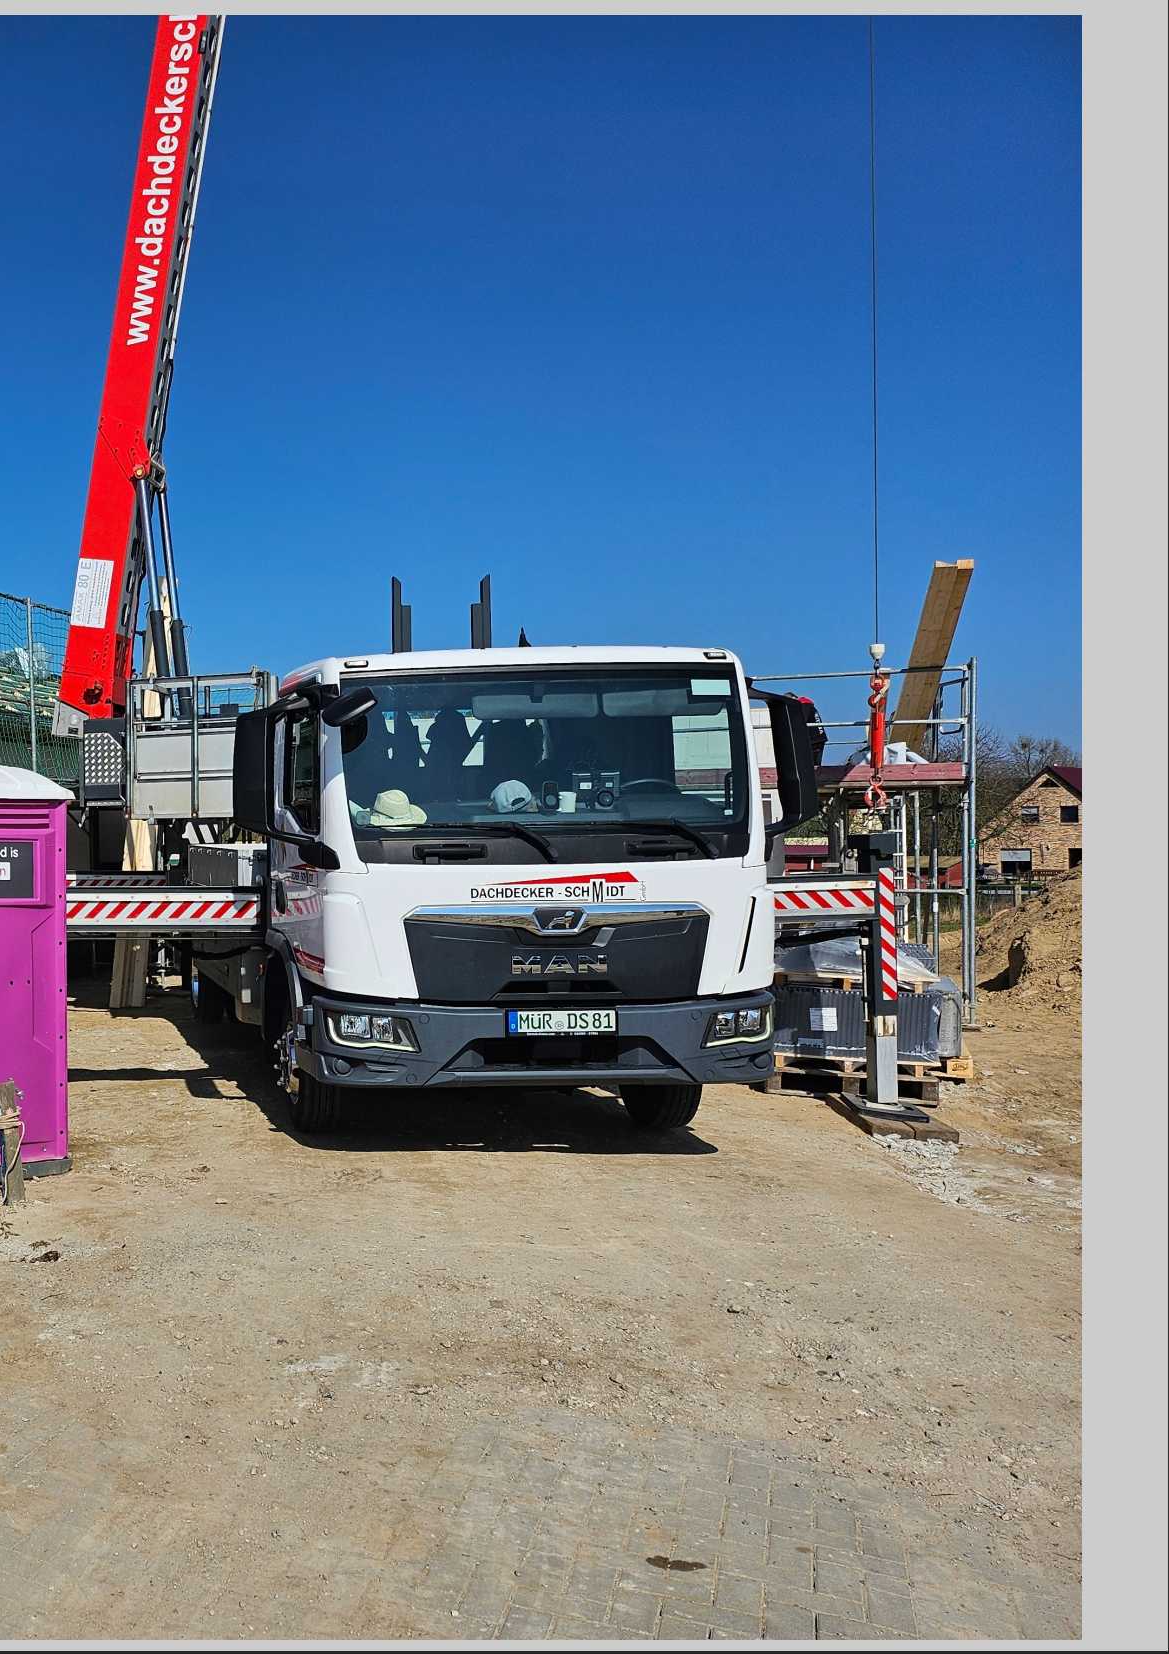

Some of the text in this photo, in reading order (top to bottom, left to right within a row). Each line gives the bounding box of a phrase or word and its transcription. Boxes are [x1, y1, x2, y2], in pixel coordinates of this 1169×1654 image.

[10, 846, 19, 859] is
[470, 887, 554, 899] DACHDECKER
[564, 880, 626, 903] SCHMIDT
[511, 953, 608, 975] MAN
[518, 1012, 553, 1030] MÜR
